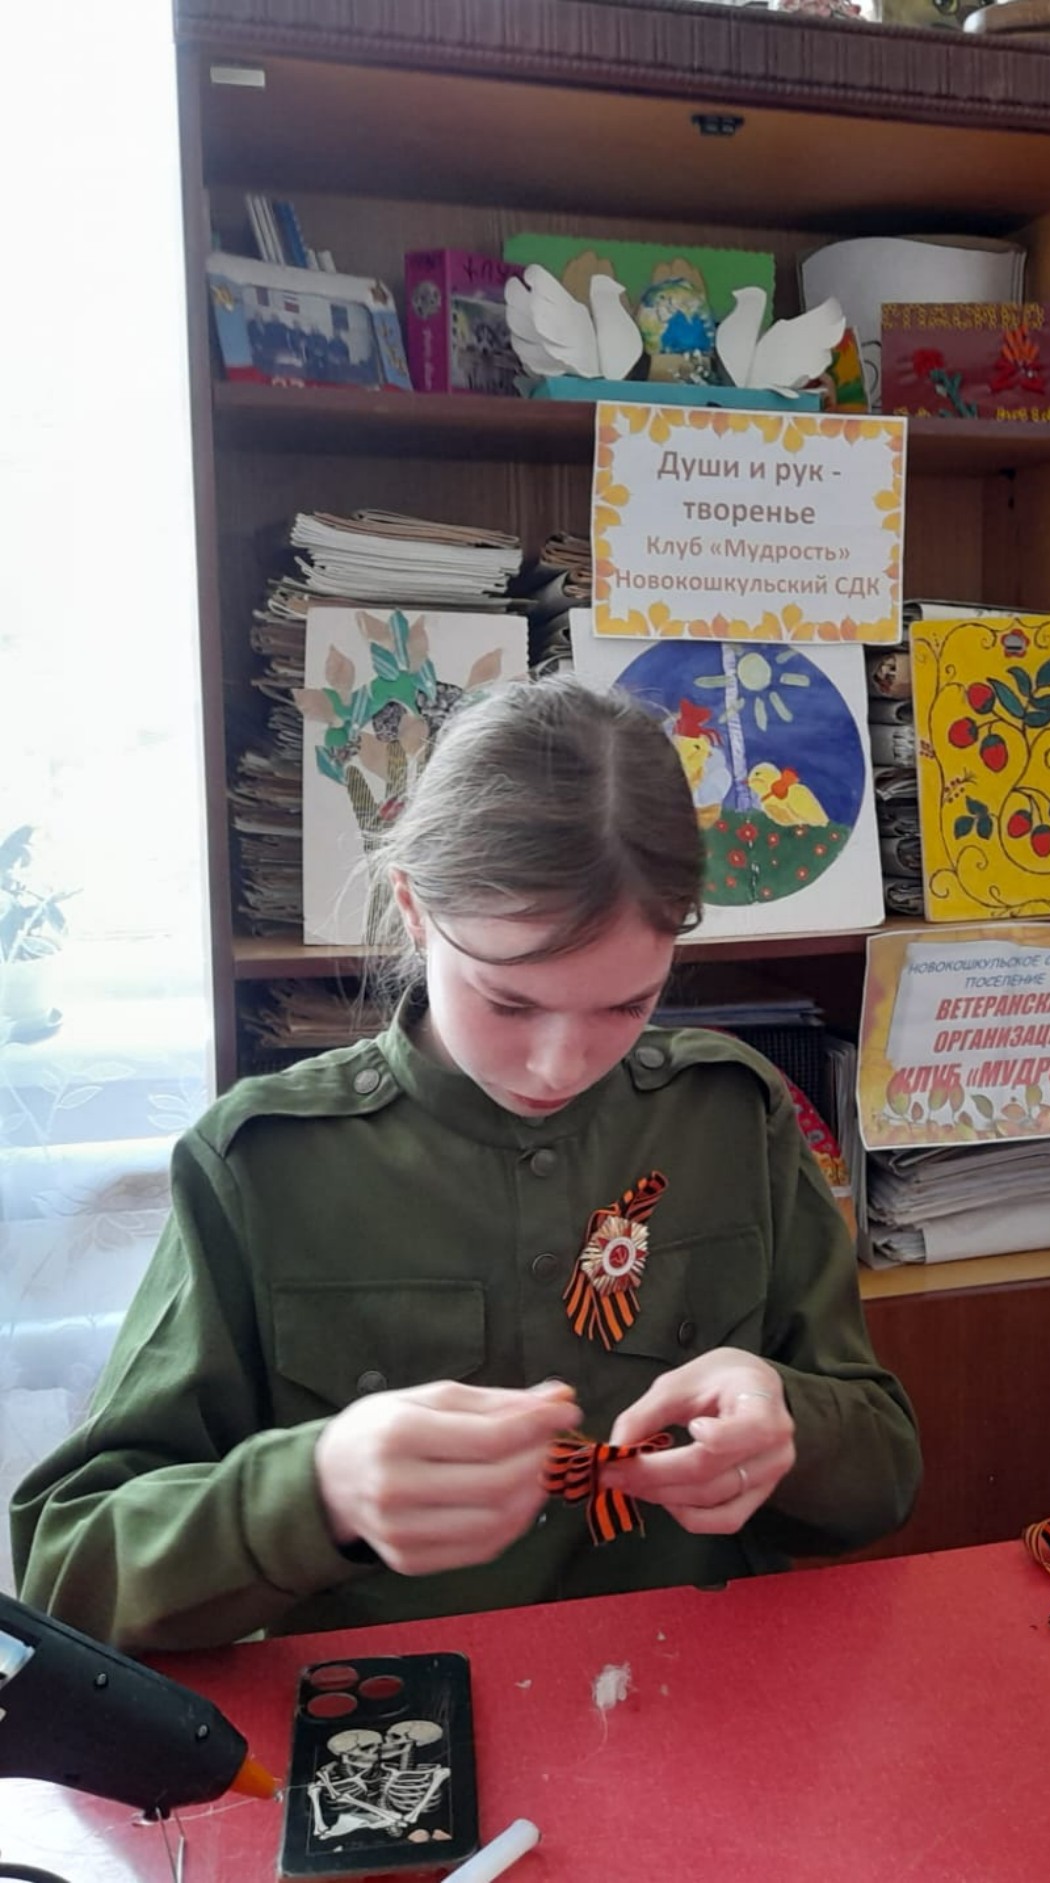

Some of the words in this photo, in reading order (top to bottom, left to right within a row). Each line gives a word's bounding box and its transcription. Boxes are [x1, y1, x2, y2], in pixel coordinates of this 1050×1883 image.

[657, 451, 740, 481] Души
[749, 461, 765, 479] и
[775, 462, 824, 486] рук
[683, 501, 816, 527] творенье
[647, 536, 703, 560] Клуб
[710, 540, 850, 564] «Мудрость»
[616, 570, 827, 596] Новокошкульский
[835, 577, 880, 598] СДК
[908, 955, 1041, 975] НОВОКОШКУЛЬСКОЕ
[965, 973, 1047, 989] ПОСЕЛЕНИЕ
[895, 1064, 962, 1094] КЛУБ
